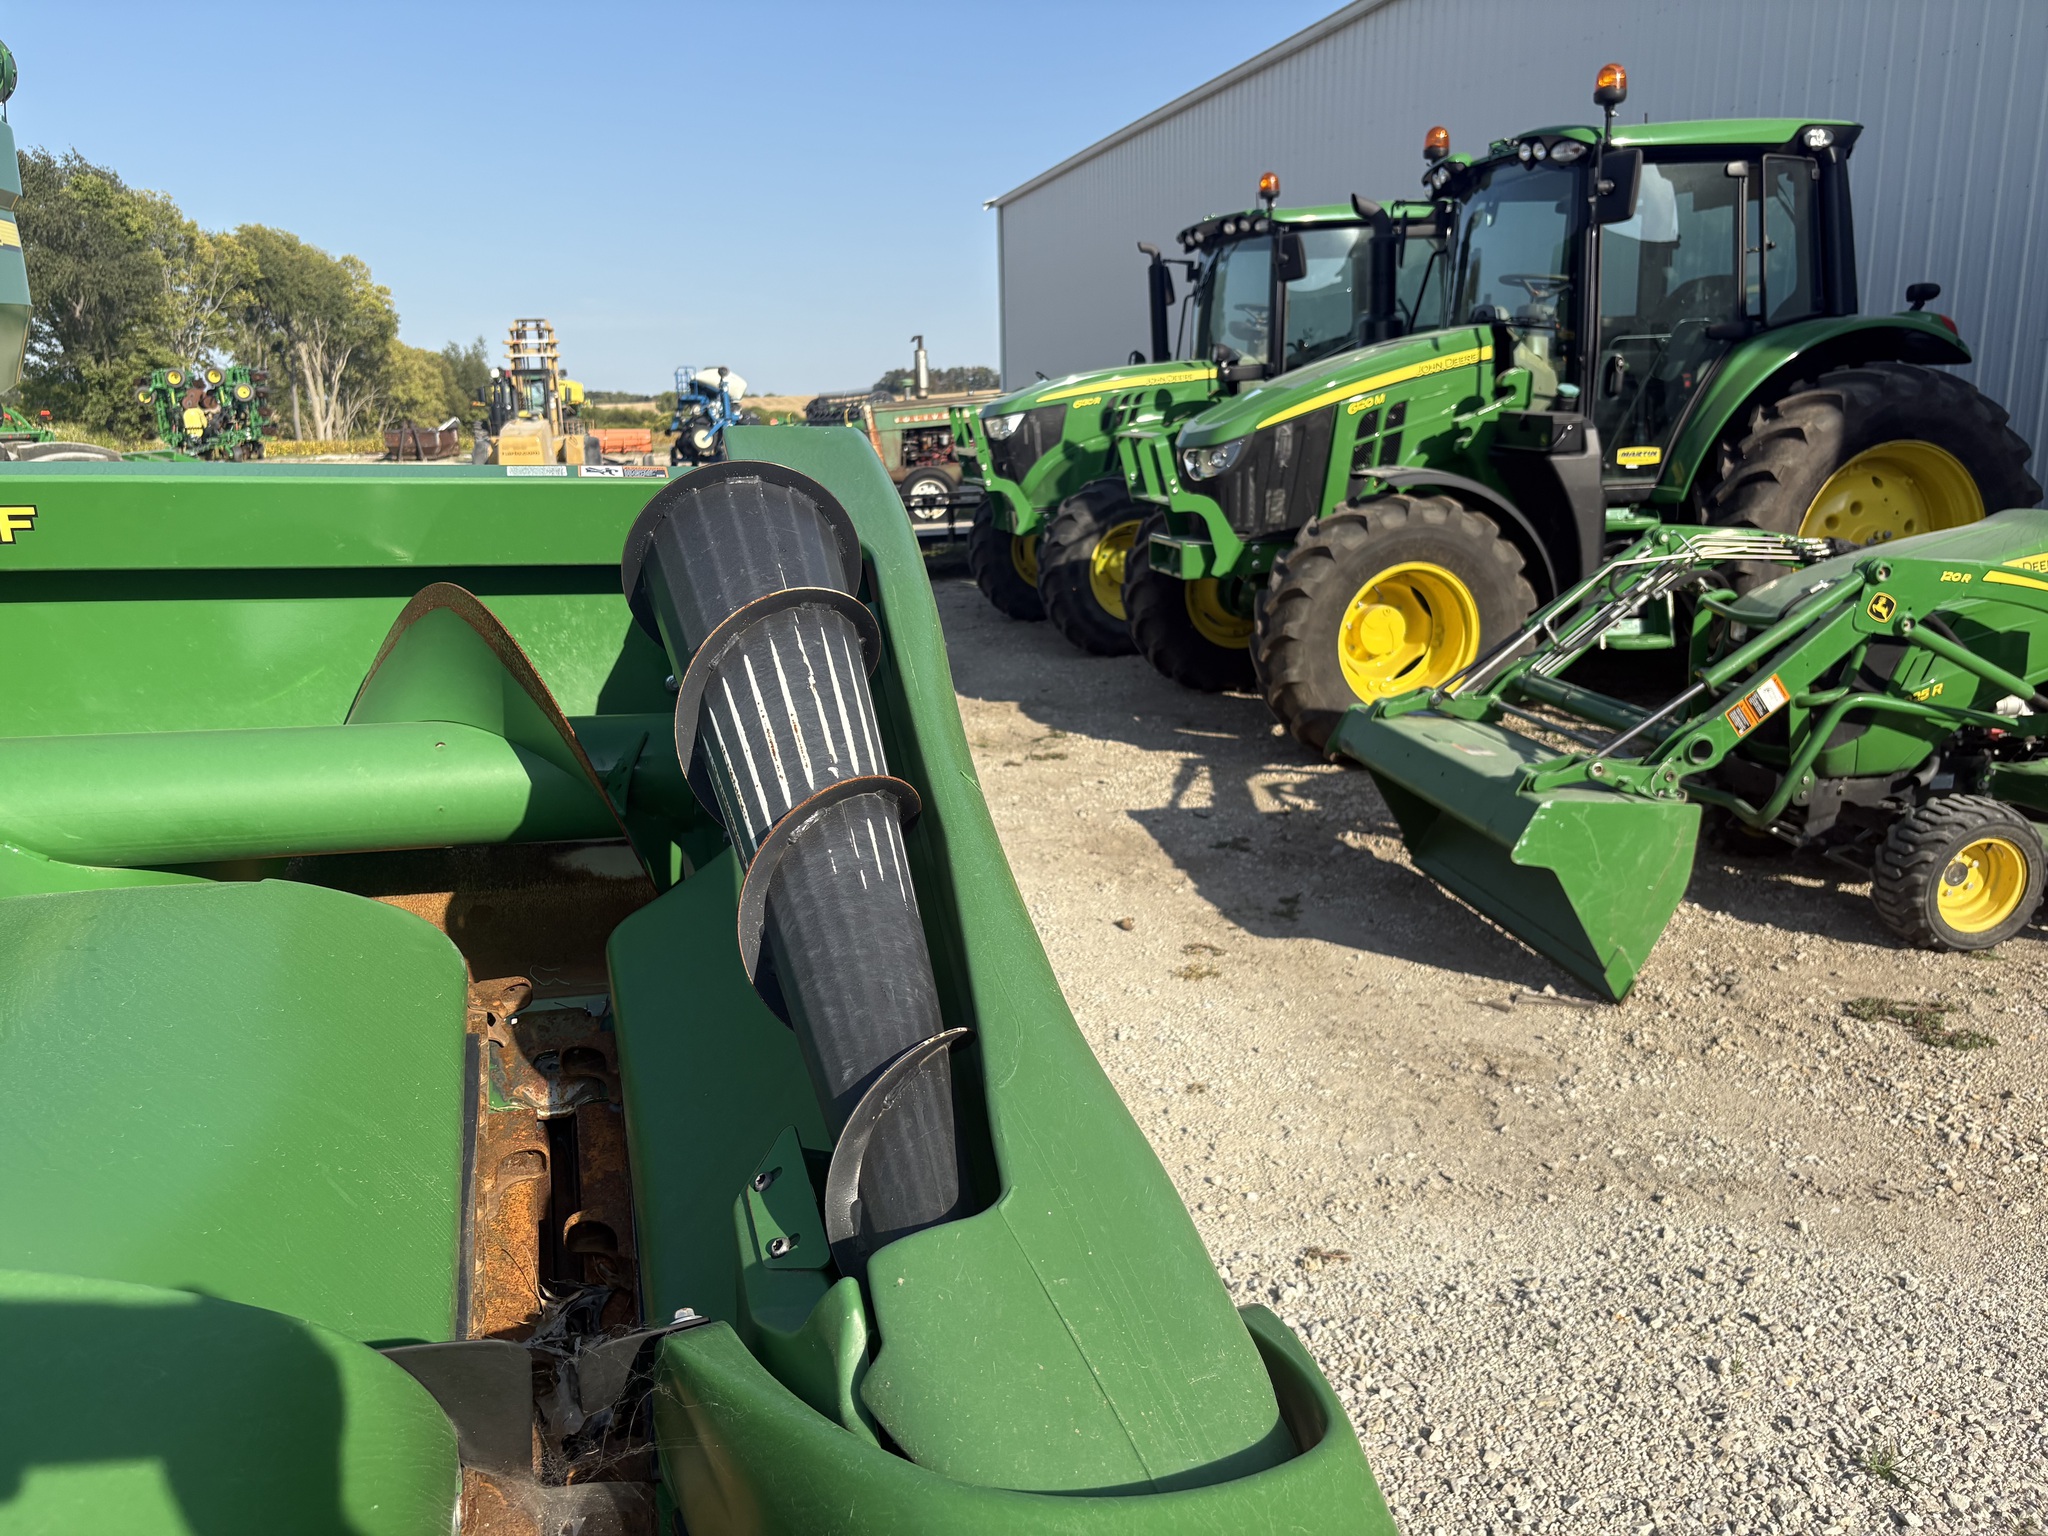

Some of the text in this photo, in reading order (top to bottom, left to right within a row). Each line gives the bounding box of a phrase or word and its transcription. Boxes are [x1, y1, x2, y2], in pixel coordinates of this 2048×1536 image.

[1416, 353, 1480, 377] JOHN DEERE
[2022, 560, 2048, 572] DEE
